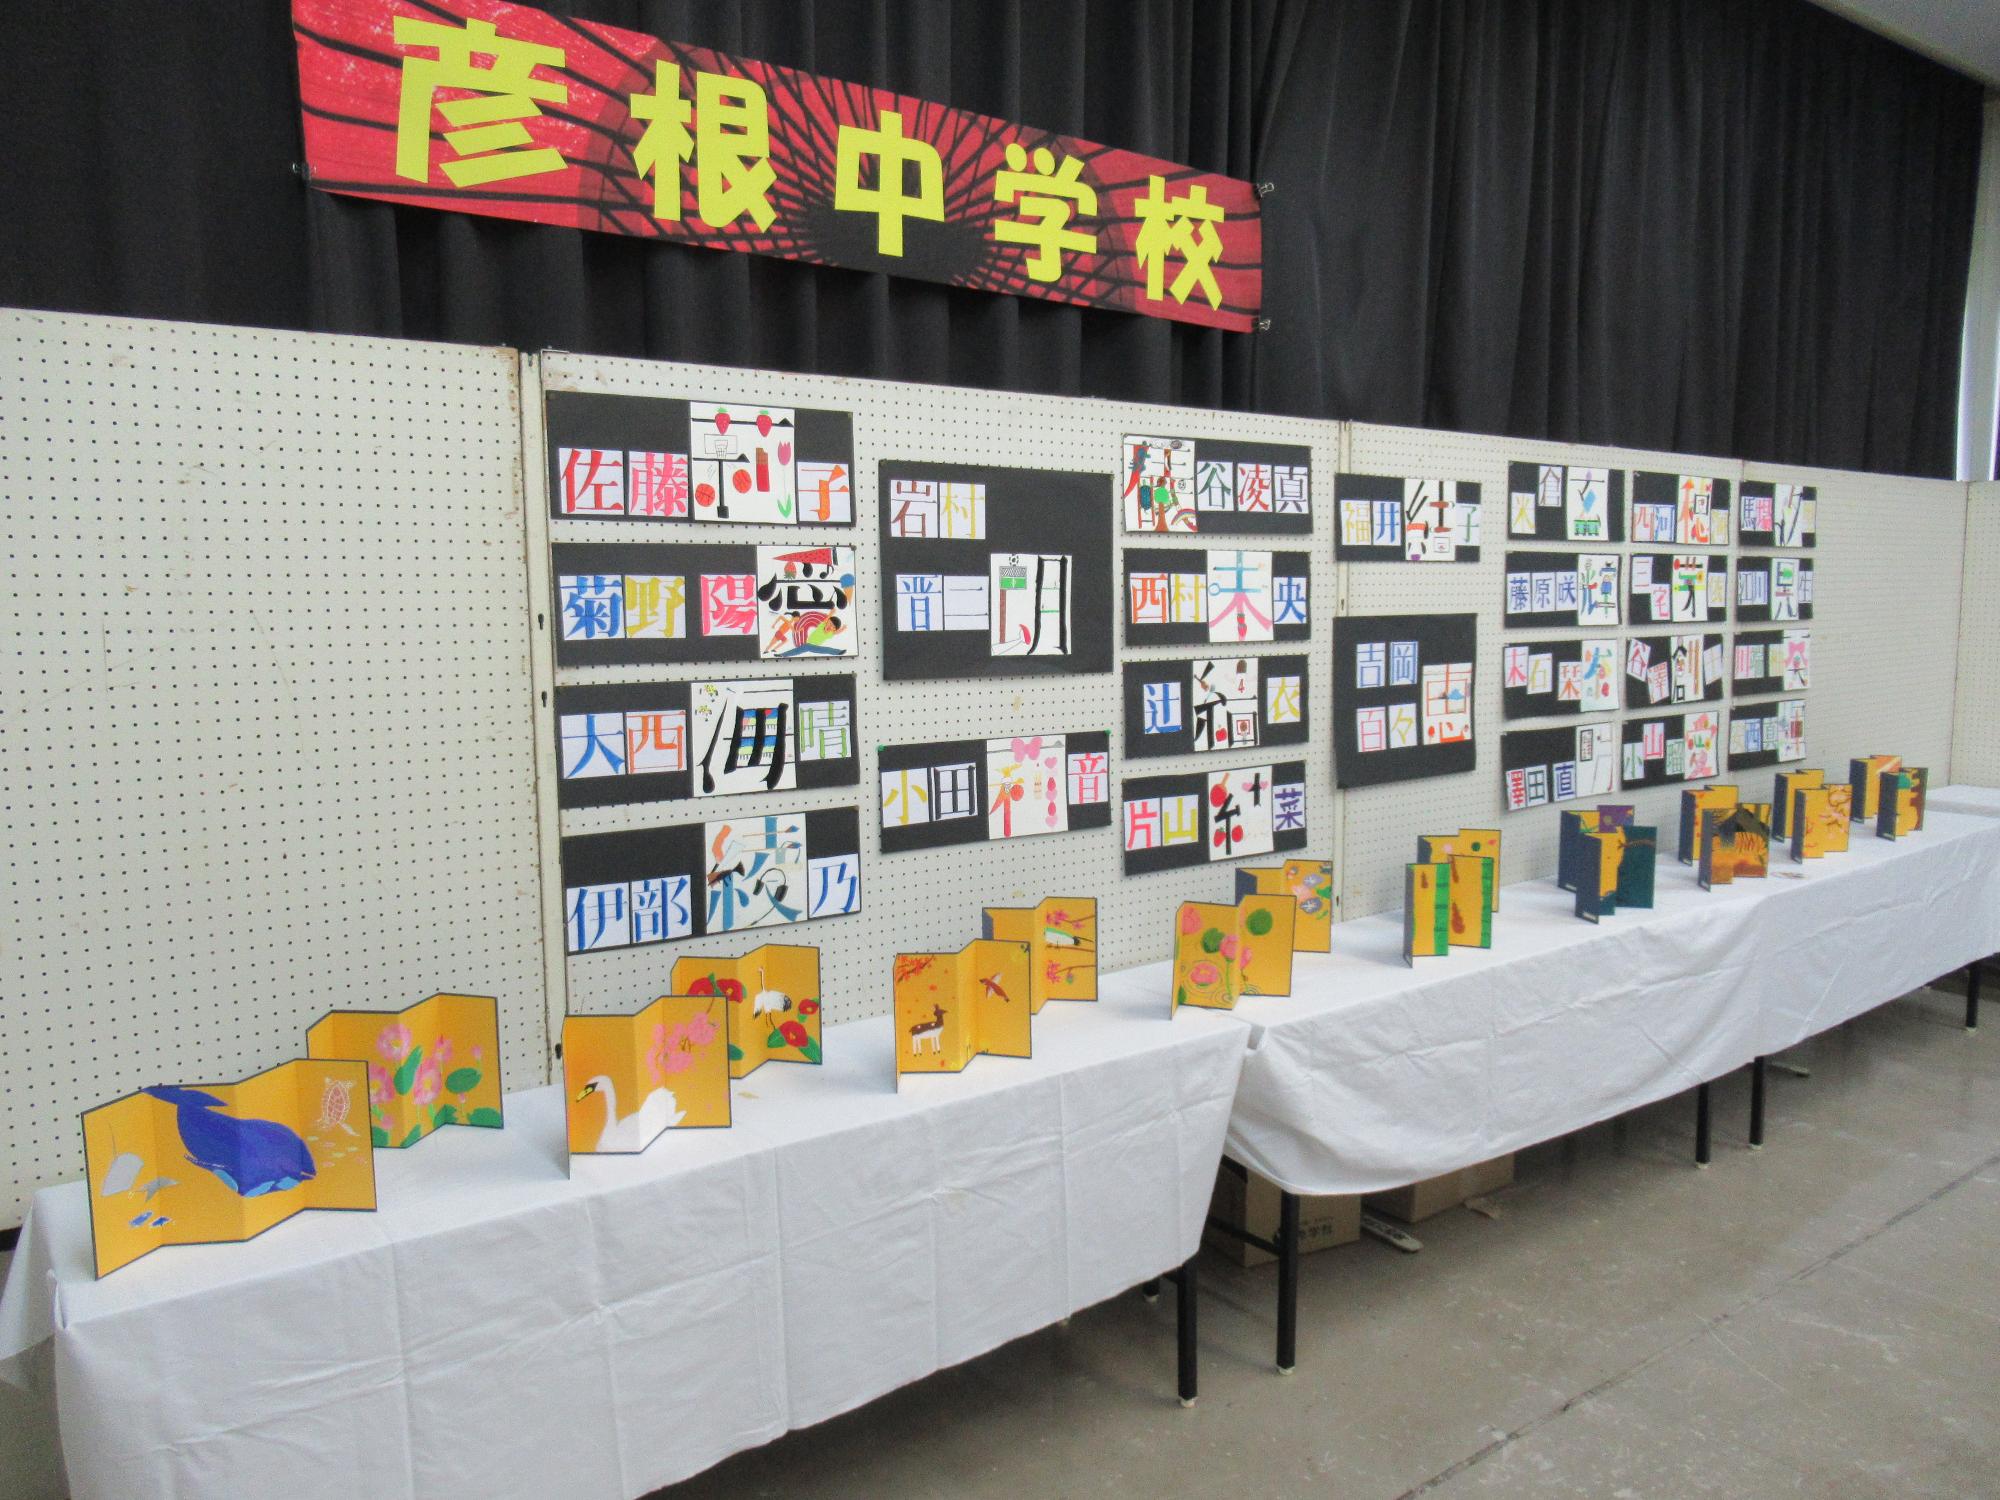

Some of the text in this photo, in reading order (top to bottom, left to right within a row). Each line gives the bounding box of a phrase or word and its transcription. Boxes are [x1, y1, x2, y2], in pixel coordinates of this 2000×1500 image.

[393, 14, 1225, 311] 彦根中学校
[892, 481, 985, 538] 岩村
